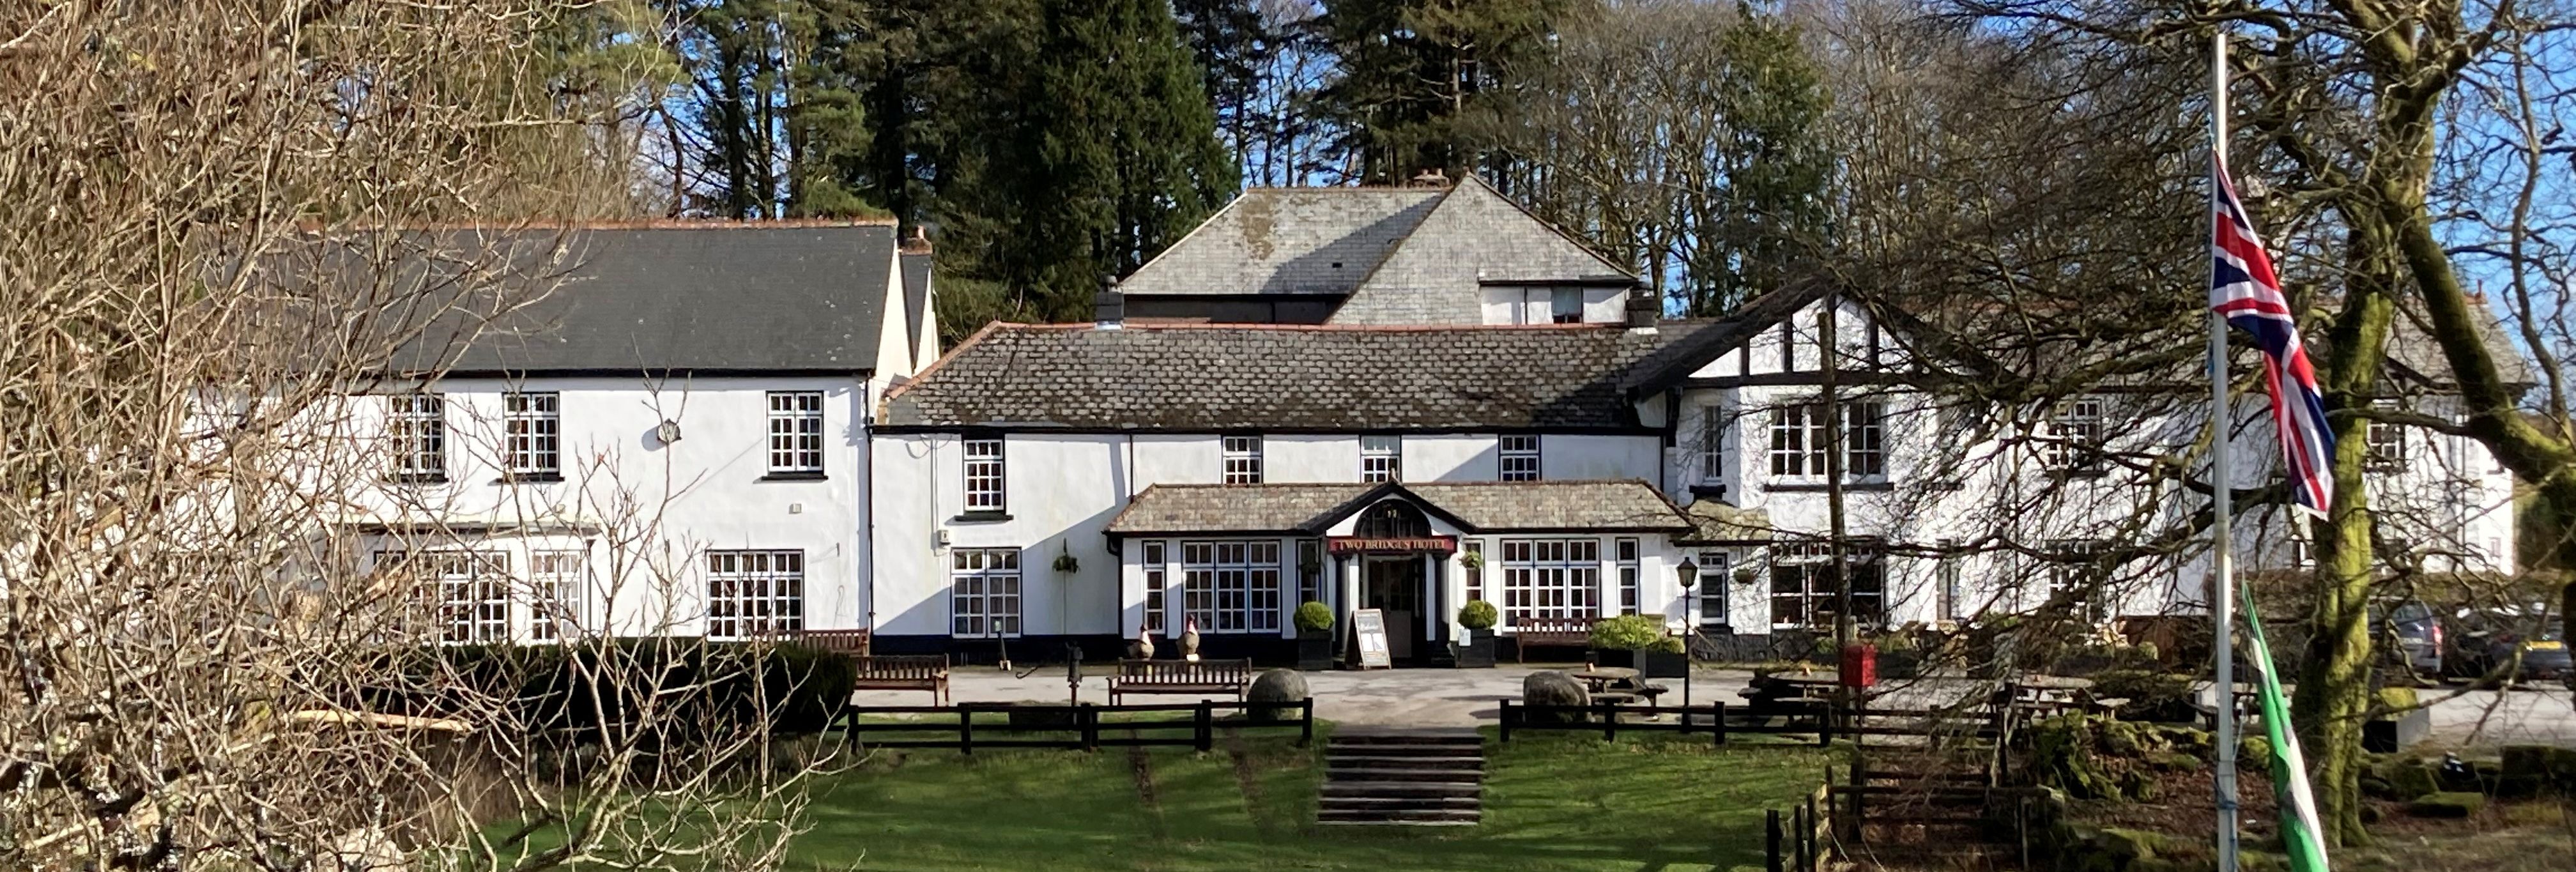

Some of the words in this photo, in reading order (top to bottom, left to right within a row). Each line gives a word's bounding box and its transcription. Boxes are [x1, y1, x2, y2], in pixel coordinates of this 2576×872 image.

[1338, 539, 1363, 550] TWO
[1365, 539, 1411, 549] BRIDGES
[1413, 539, 1445, 549] HOTEL
